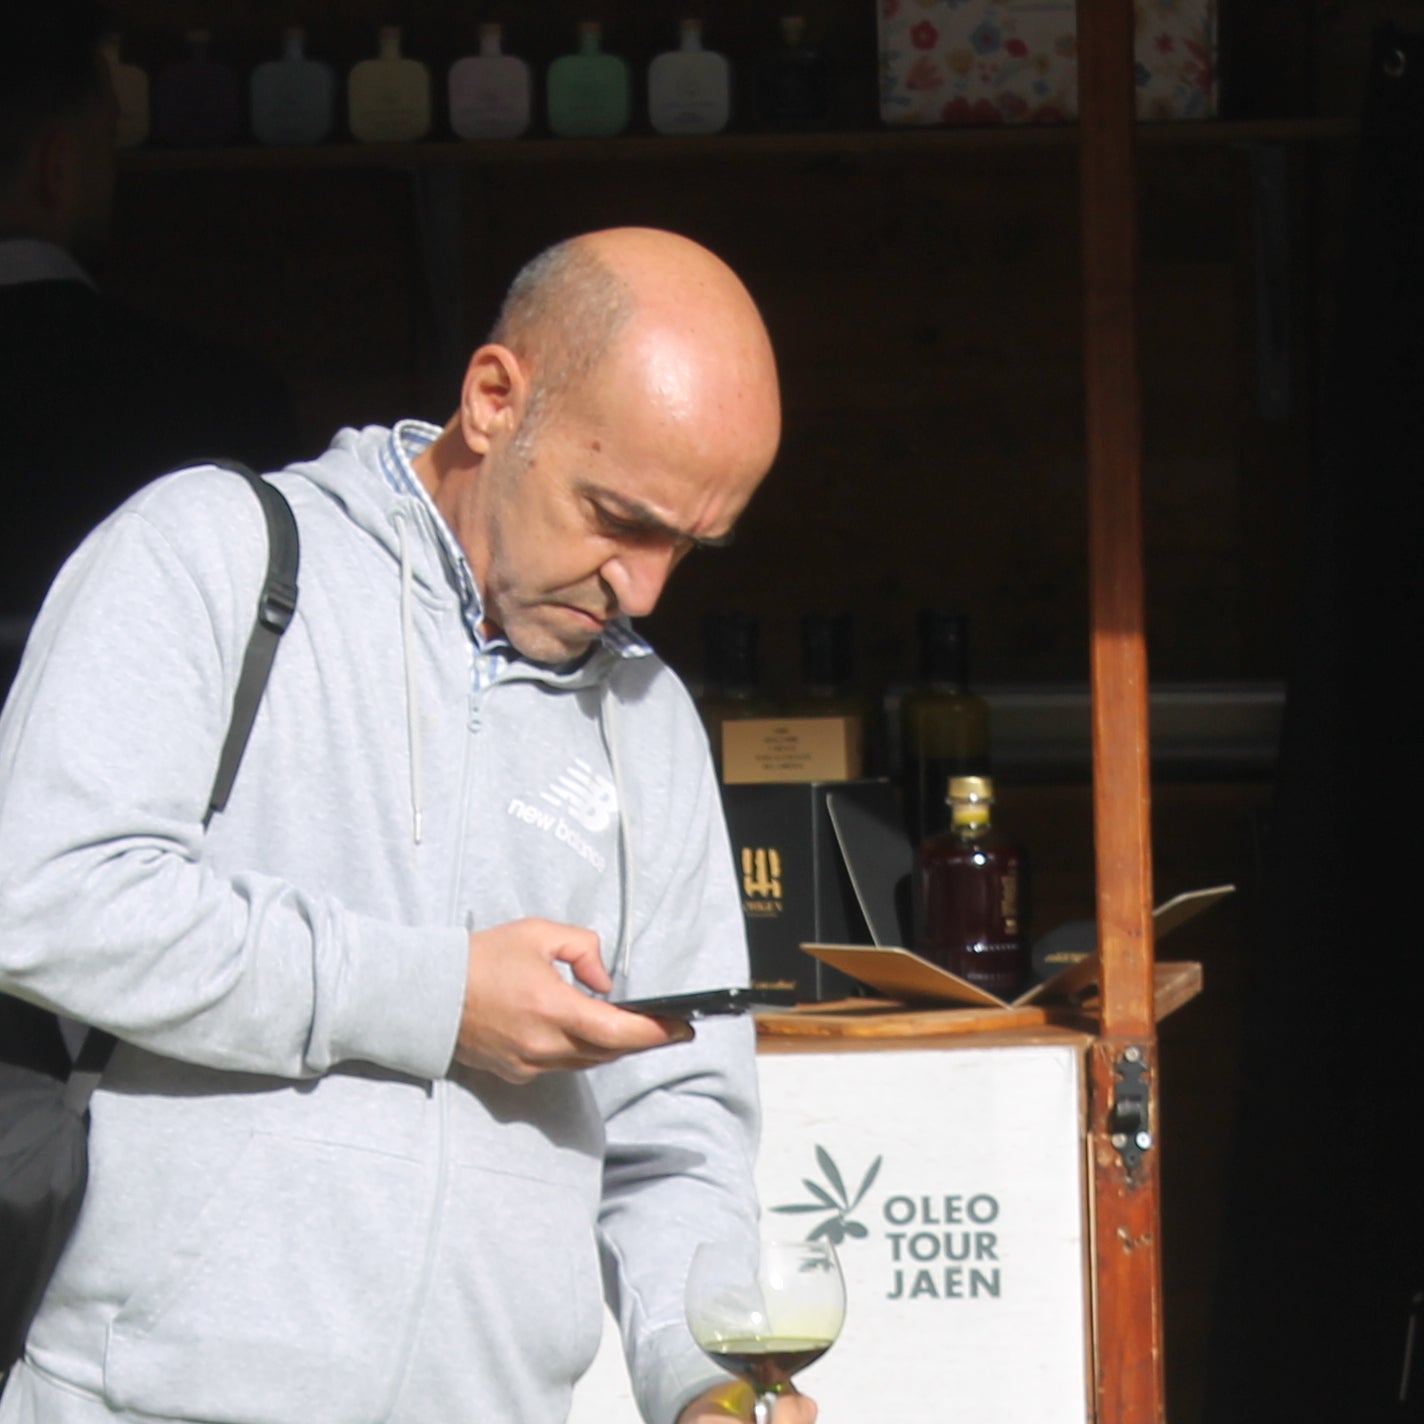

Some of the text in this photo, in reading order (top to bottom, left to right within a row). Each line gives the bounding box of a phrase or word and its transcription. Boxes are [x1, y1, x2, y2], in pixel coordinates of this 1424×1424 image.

[507, 797, 556, 831] new
[883, 1194, 1000, 1226] OLEO
[885, 1231, 1000, 1262] TOUR
